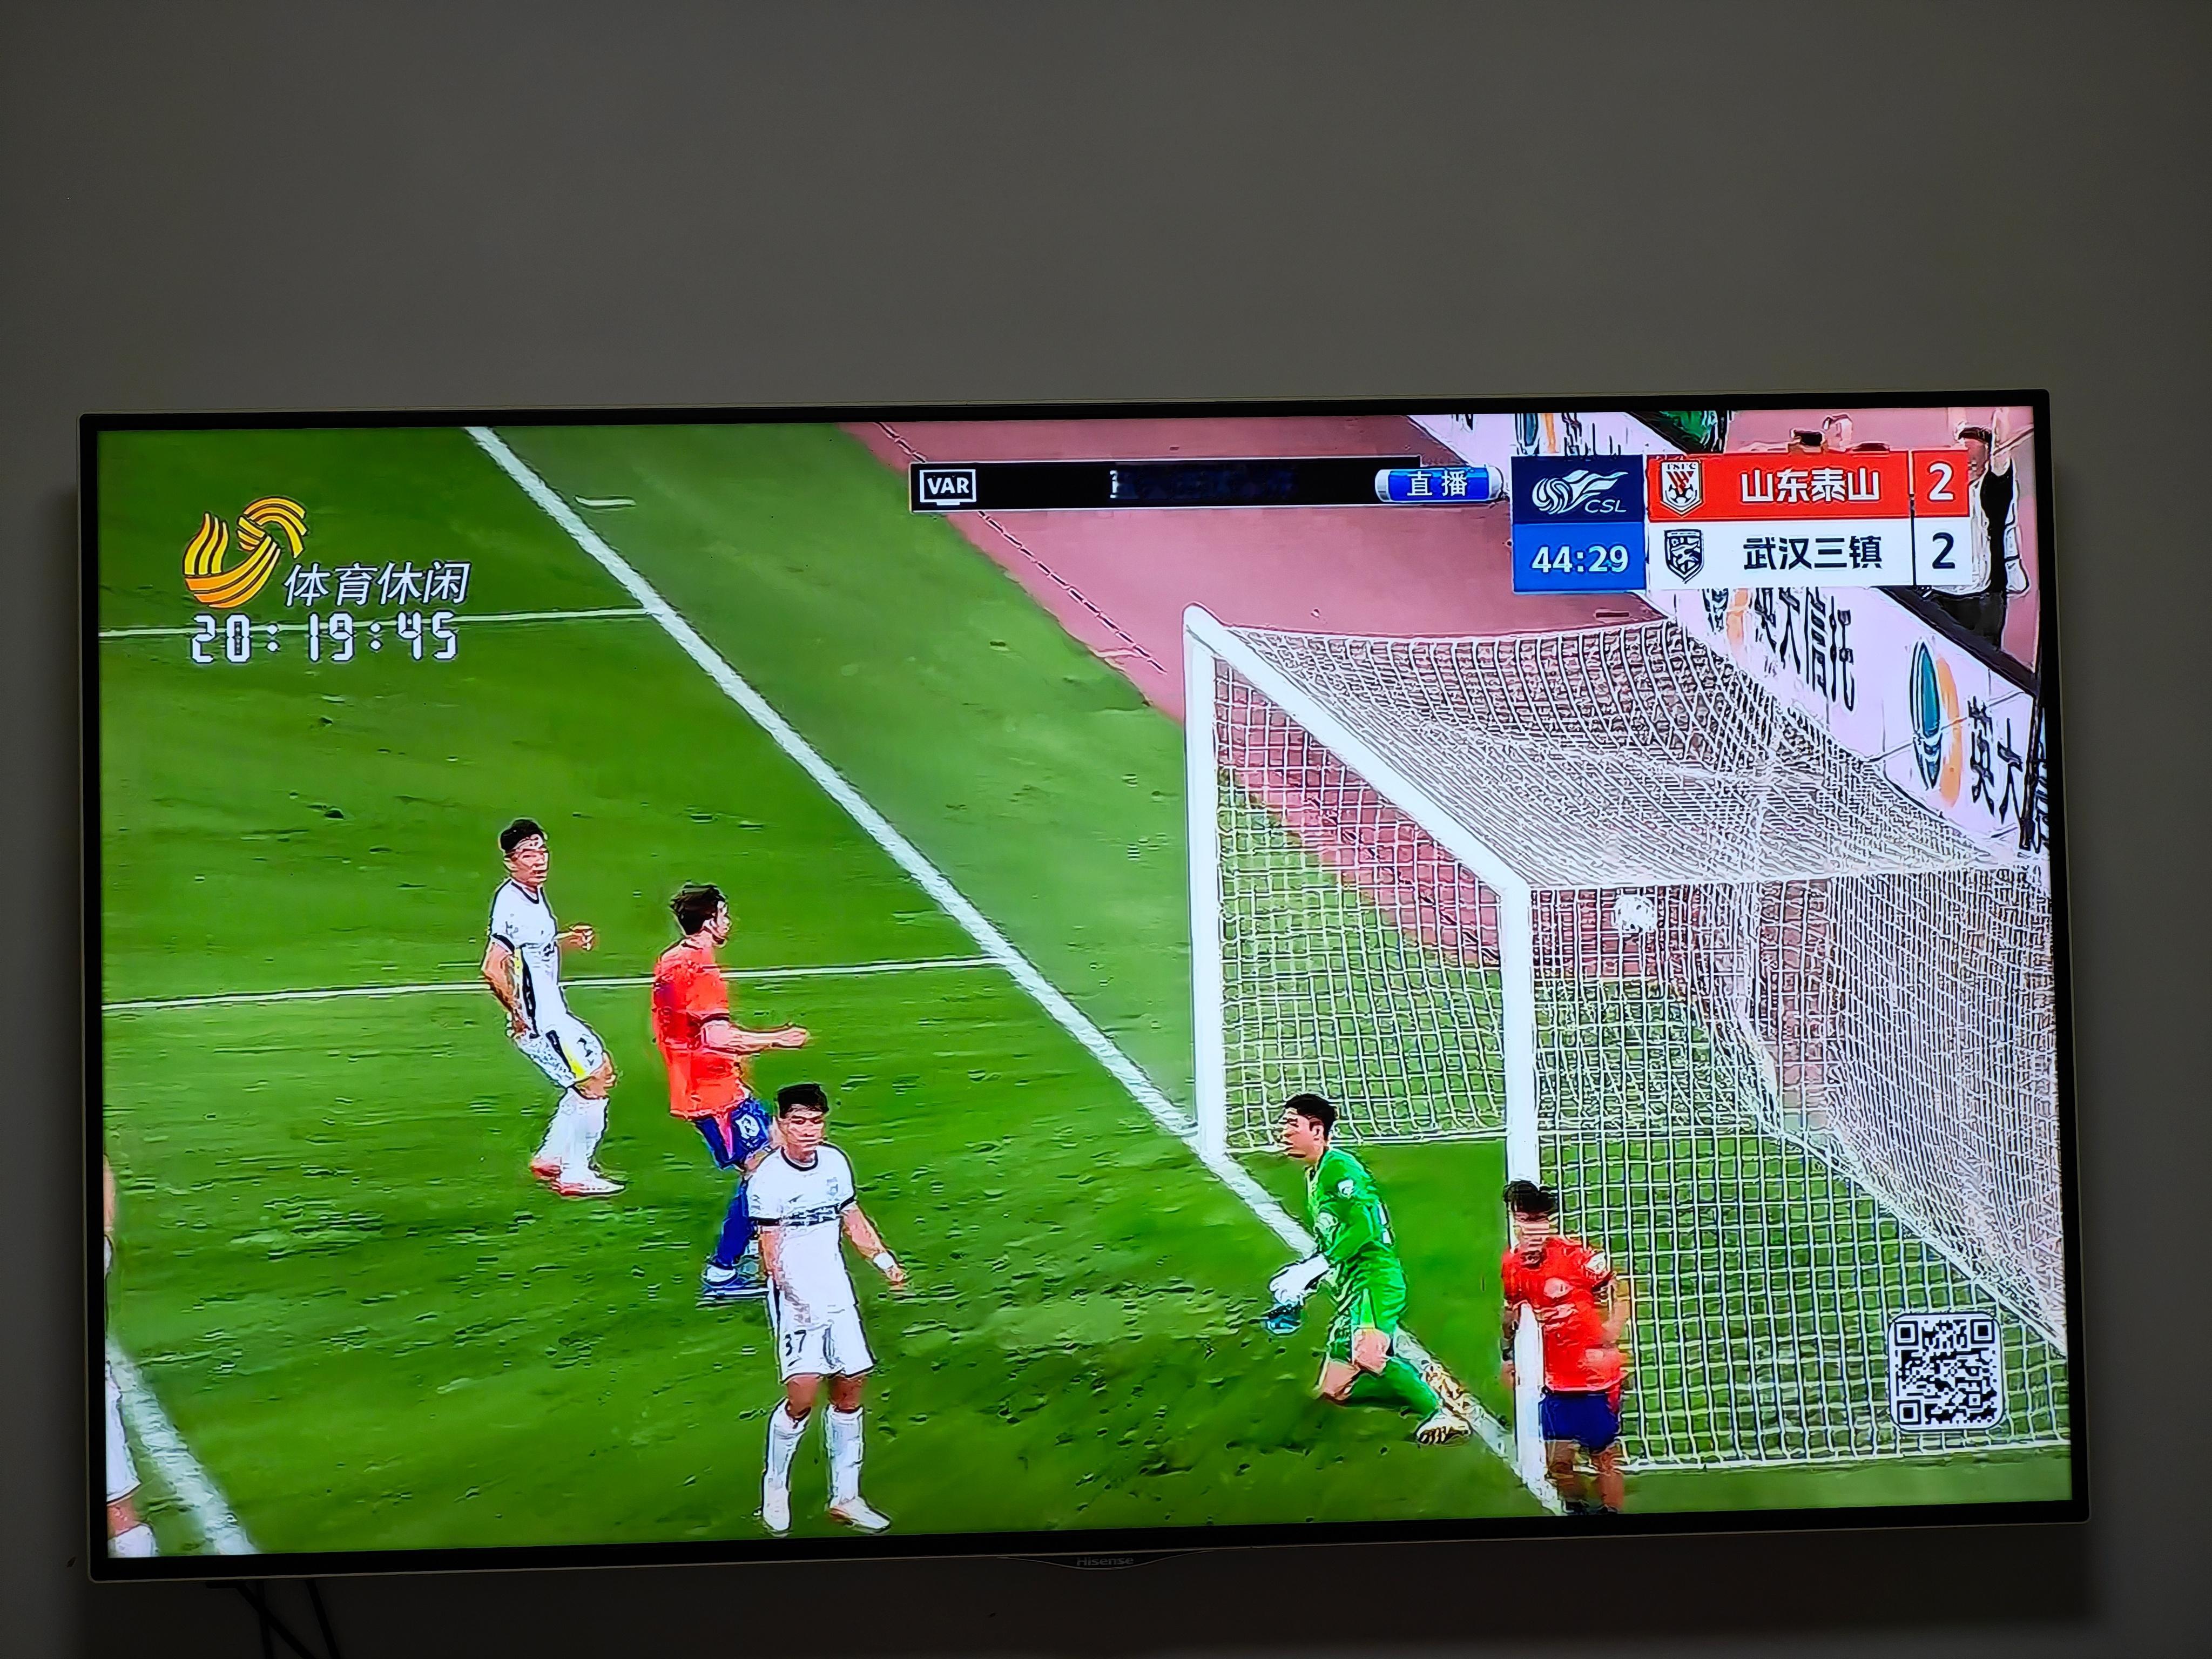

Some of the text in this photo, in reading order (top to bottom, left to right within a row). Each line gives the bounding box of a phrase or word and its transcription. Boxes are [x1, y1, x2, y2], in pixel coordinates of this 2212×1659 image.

[927, 477, 969, 495] VAR
[1407, 470, 1468, 497] 直播
[1740, 463, 1955, 503] 山东泰山 2
[1584, 499, 1627, 513] CSL
[1532, 545, 1629, 573] 44:29
[1743, 532, 1955, 570] 武汉三镇 2
[284, 562, 471, 607] 体育休闲
[1076, 1556, 1134, 1566] Hisense
